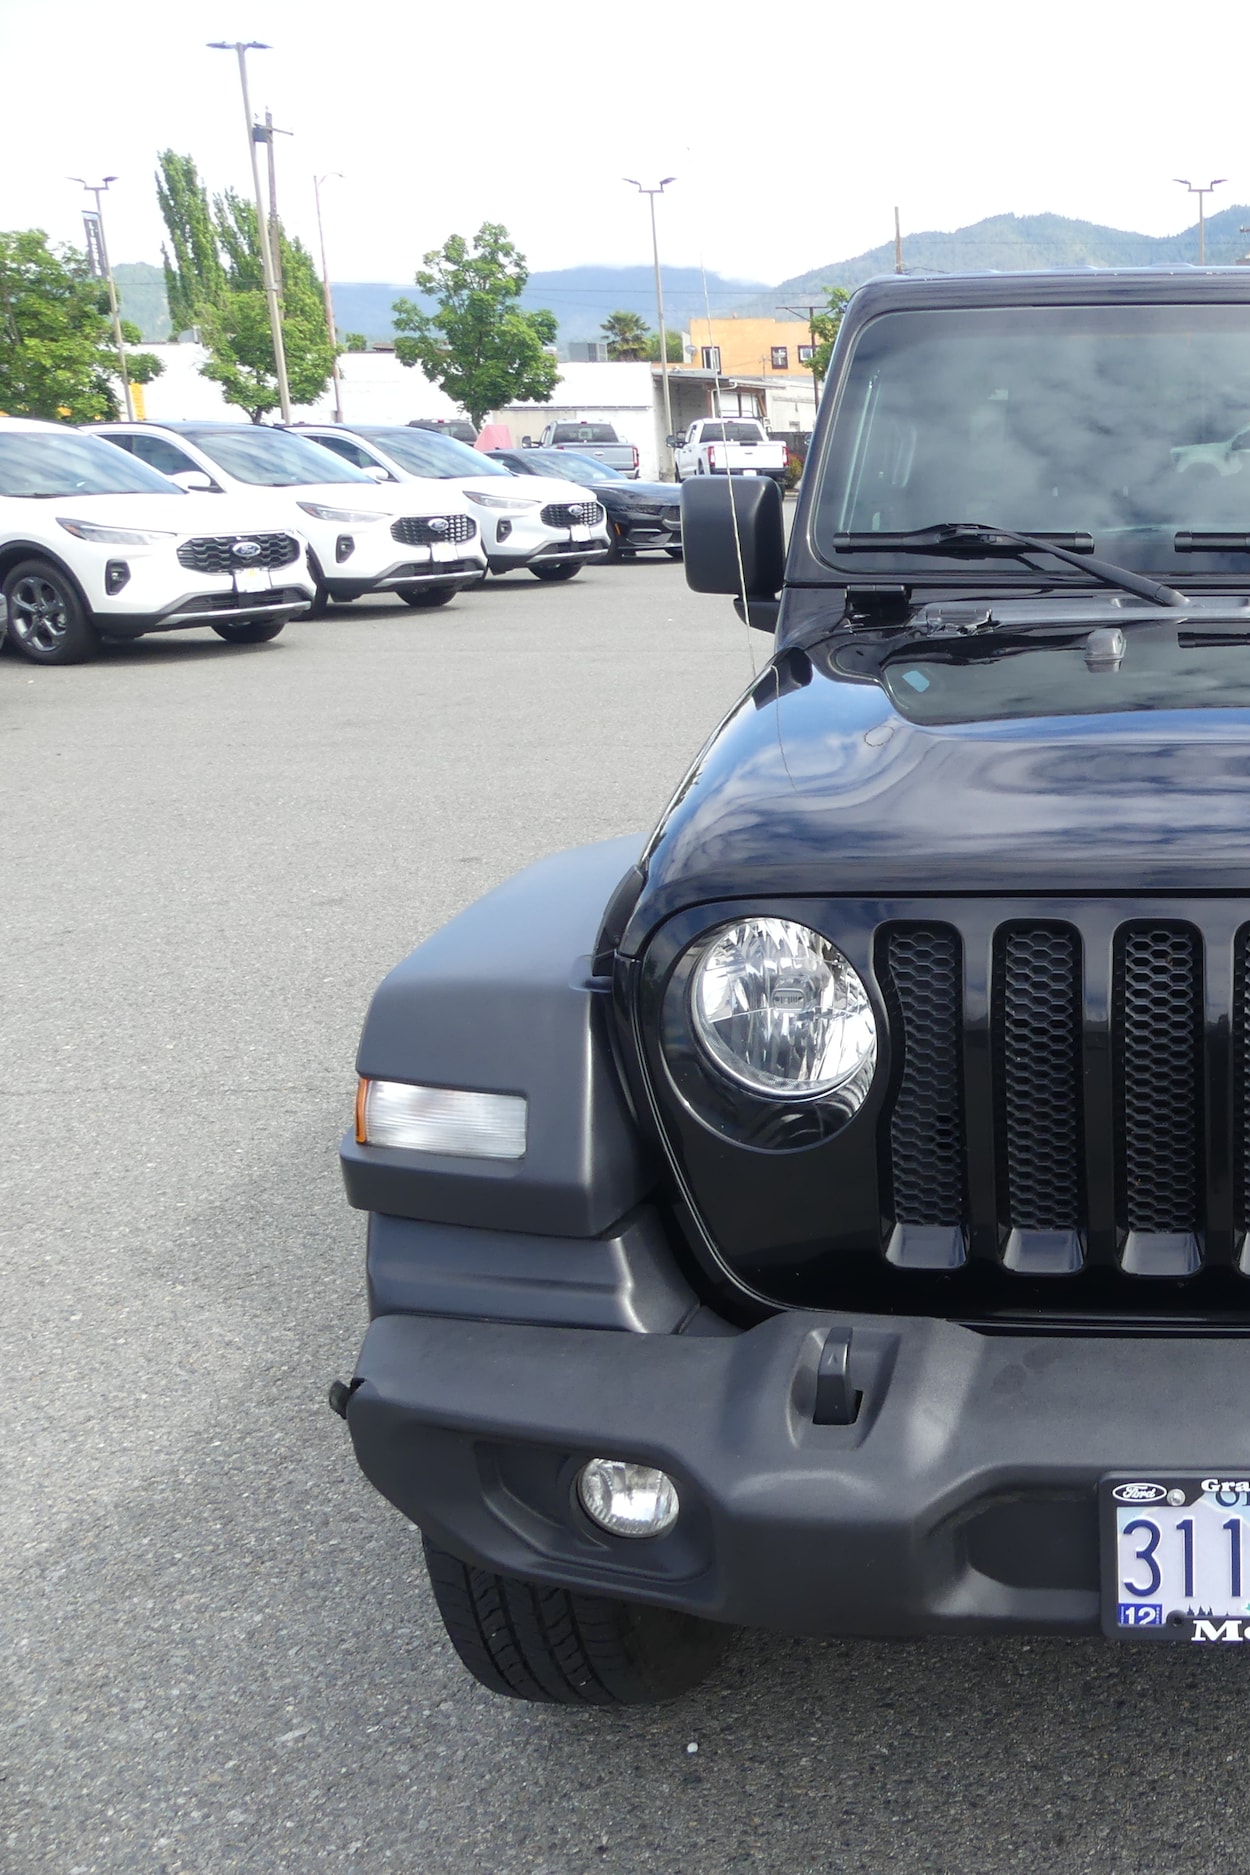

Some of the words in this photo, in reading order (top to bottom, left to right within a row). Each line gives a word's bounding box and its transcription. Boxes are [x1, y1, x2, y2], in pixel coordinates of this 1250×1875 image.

[1123, 1486, 1156, 1498] Ford
[1123, 1519, 1241, 1597] 311
[1125, 1606, 1156, 1624] 12
